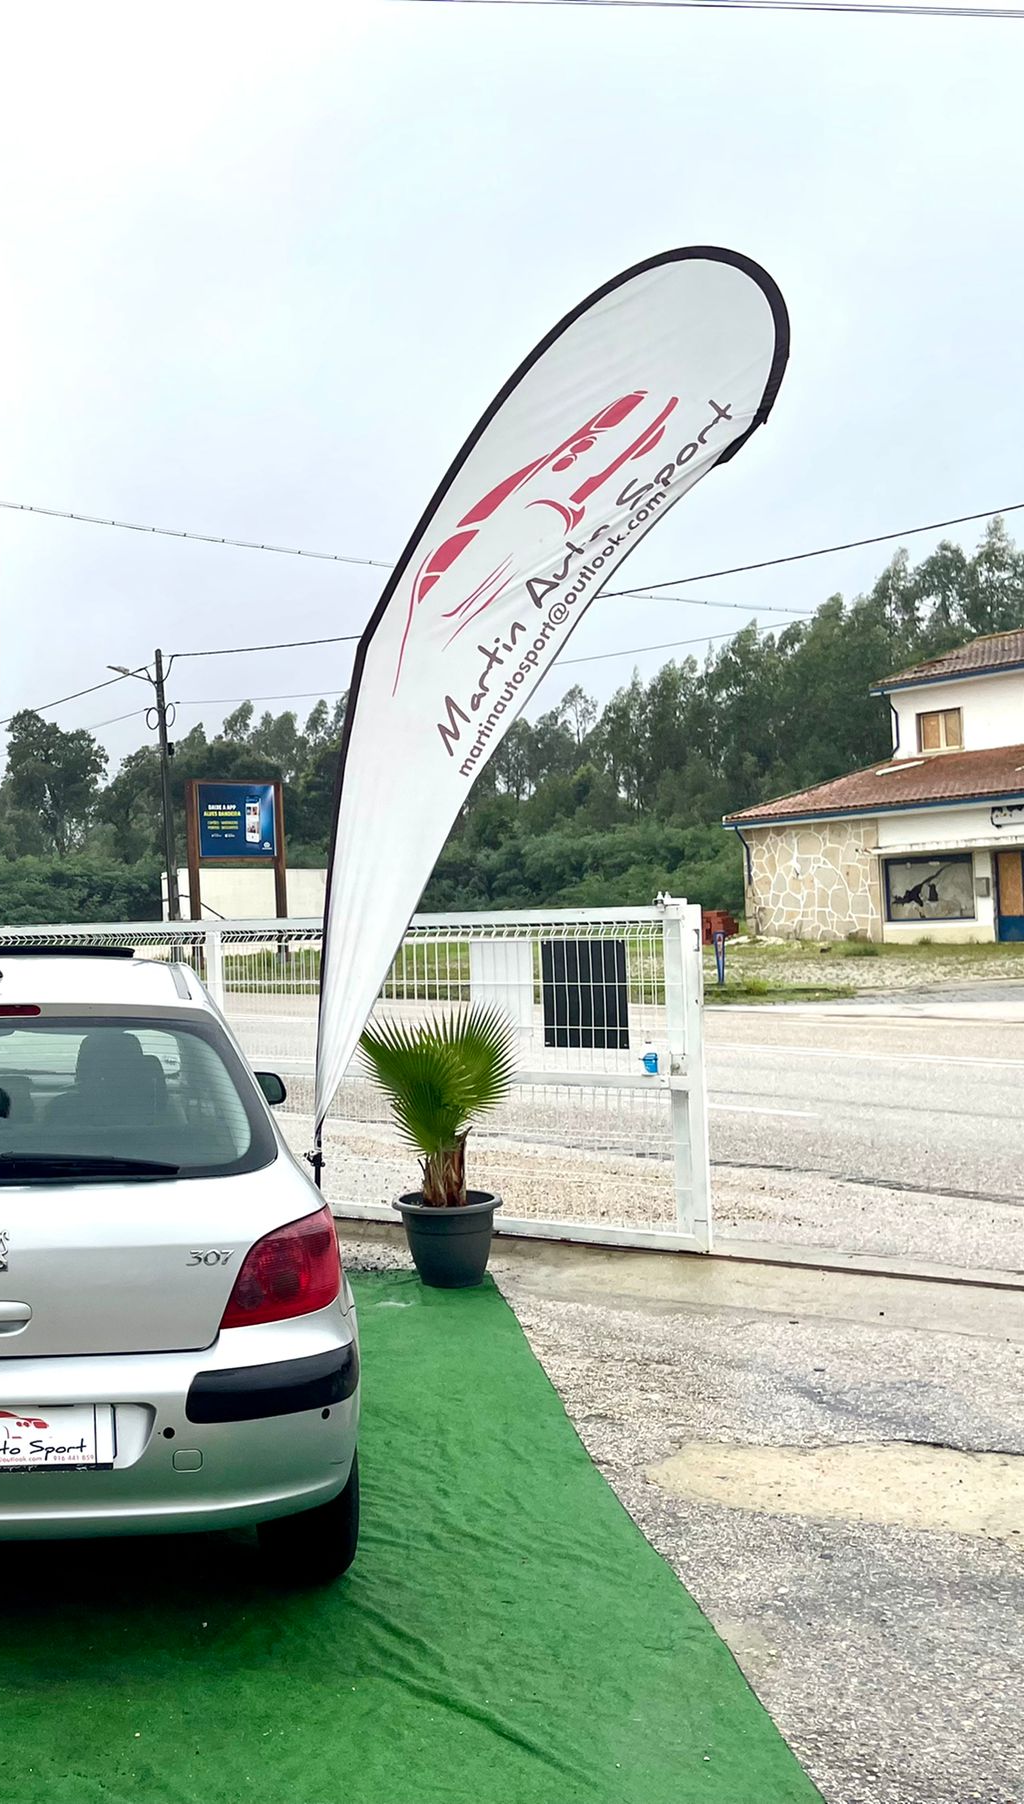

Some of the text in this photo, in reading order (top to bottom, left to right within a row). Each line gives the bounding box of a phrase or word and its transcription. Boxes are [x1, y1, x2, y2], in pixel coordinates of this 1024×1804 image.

[436, 621, 527, 757] Martin
[615, 399, 733, 511] Sport
[458, 490, 668, 778] martinautosport@outlook.com
[185, 1249, 235, 1266] 307
[29, 1437, 87, 1461] Sport
